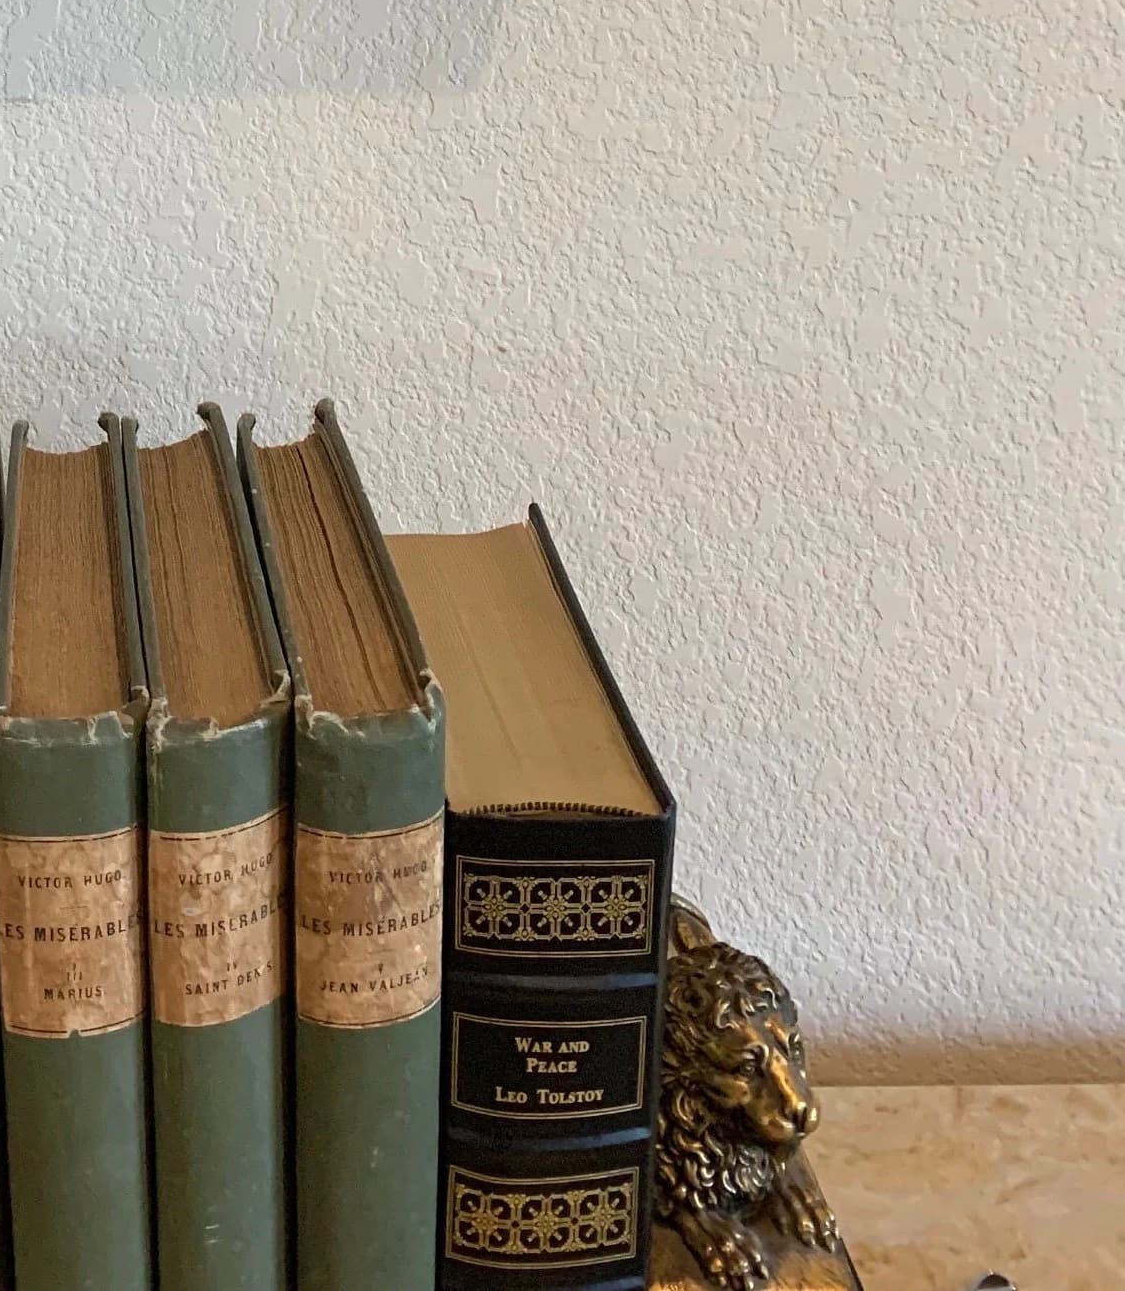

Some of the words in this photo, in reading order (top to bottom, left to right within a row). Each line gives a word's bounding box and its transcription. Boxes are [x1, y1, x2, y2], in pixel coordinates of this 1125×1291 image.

[18, 875, 73, 889] VICTOR
[83, 869, 122, 886] HUGO
[178, 869, 232, 886] VICTOR
[240, 853, 273, 876] HUGO
[329, 870, 384, 885] VICTOR
[154, 919, 185, 938] LES
[300, 915, 332, 935] LES
[185, 979, 228, 996] SAINT
[319, 982, 359, 995] JEAN
